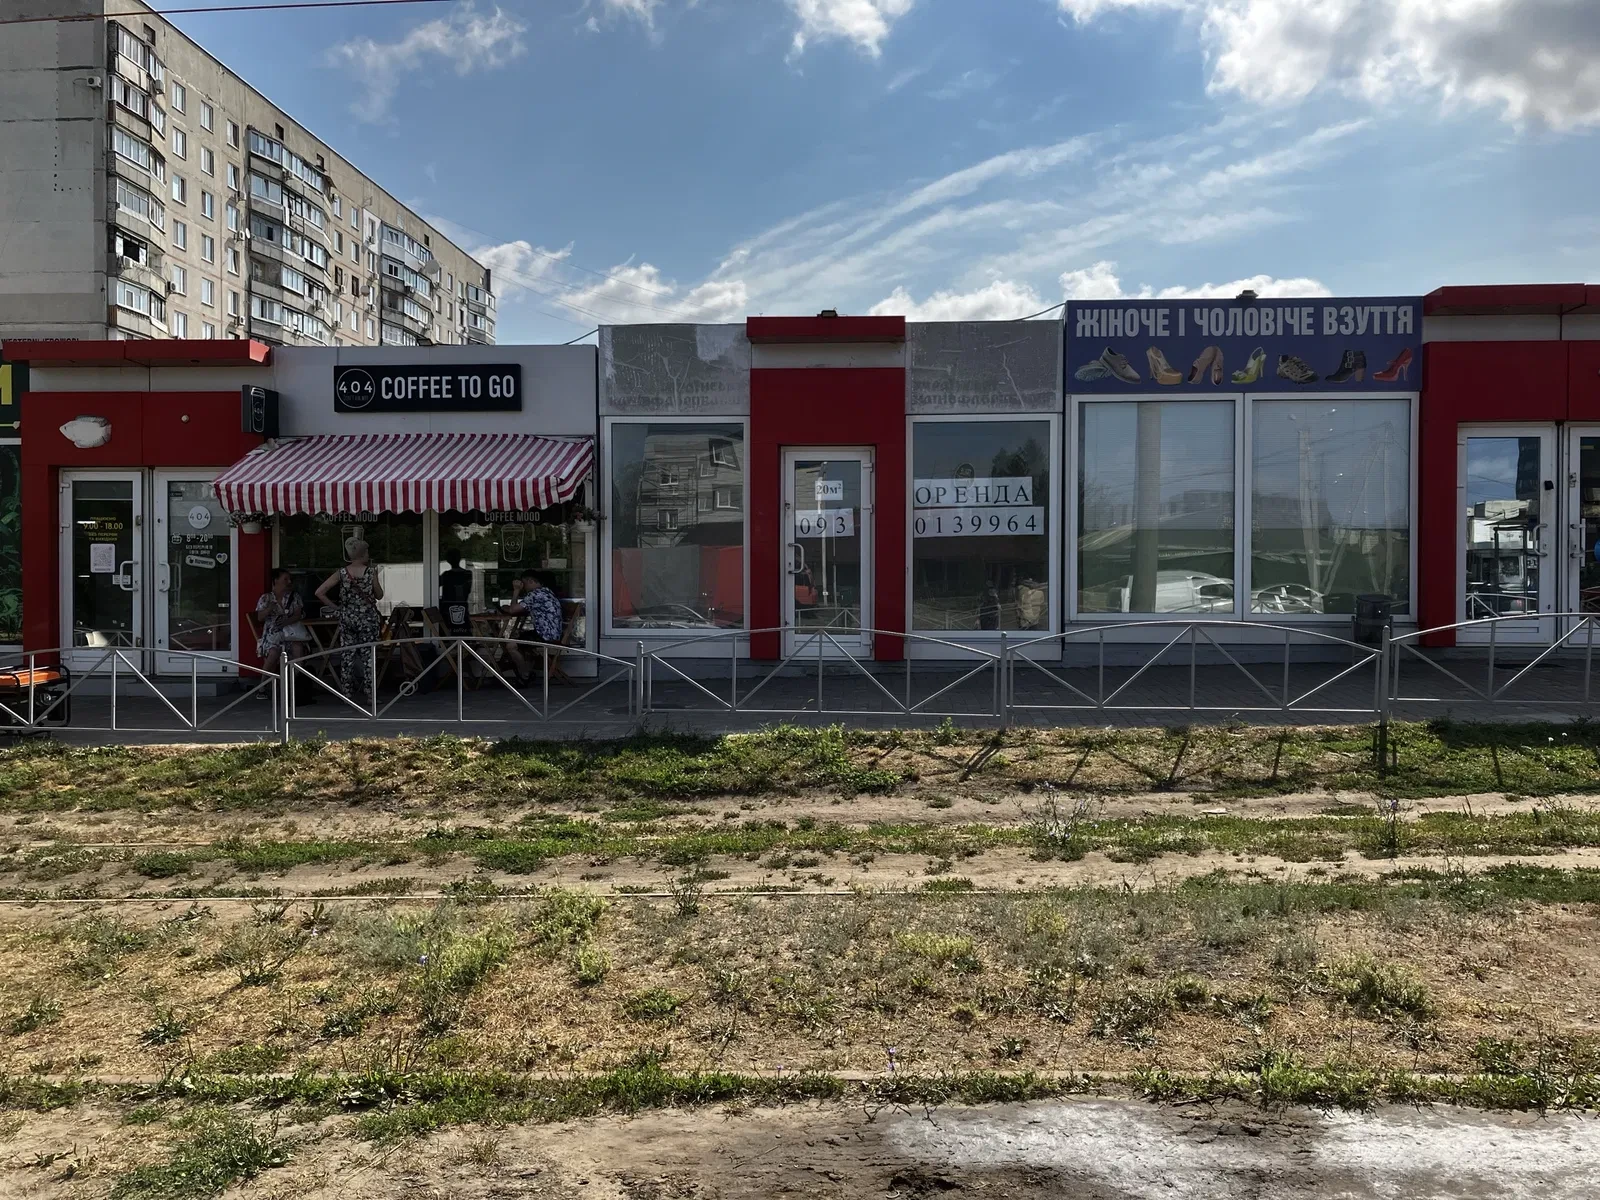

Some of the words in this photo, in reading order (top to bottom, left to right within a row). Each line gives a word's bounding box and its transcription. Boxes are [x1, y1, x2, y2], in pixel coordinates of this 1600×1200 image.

[1076, 308, 1170, 337] ЖІНОЧЕ
[1178, 308, 1185, 336] І
[1193, 307, 1315, 337] ЧОЛОВІЧЕ
[1323, 306, 1413, 335] ВЗУТТЯ
[339, 381, 374, 393] 404
[381, 376, 452, 399] COFFEE
[457, 375, 482, 398] TO
[488, 375, 515, 398] GO
[915, 485, 1030, 504] ОРЕНДА
[190, 512, 210, 520] 404
[485, 511, 514, 522] COFFEE
[517, 511, 540, 521] MOOD
[800, 516, 846, 535] 093
[915, 514, 1037, 535] 0139964
[104, 522, 124, 530] 18.00
